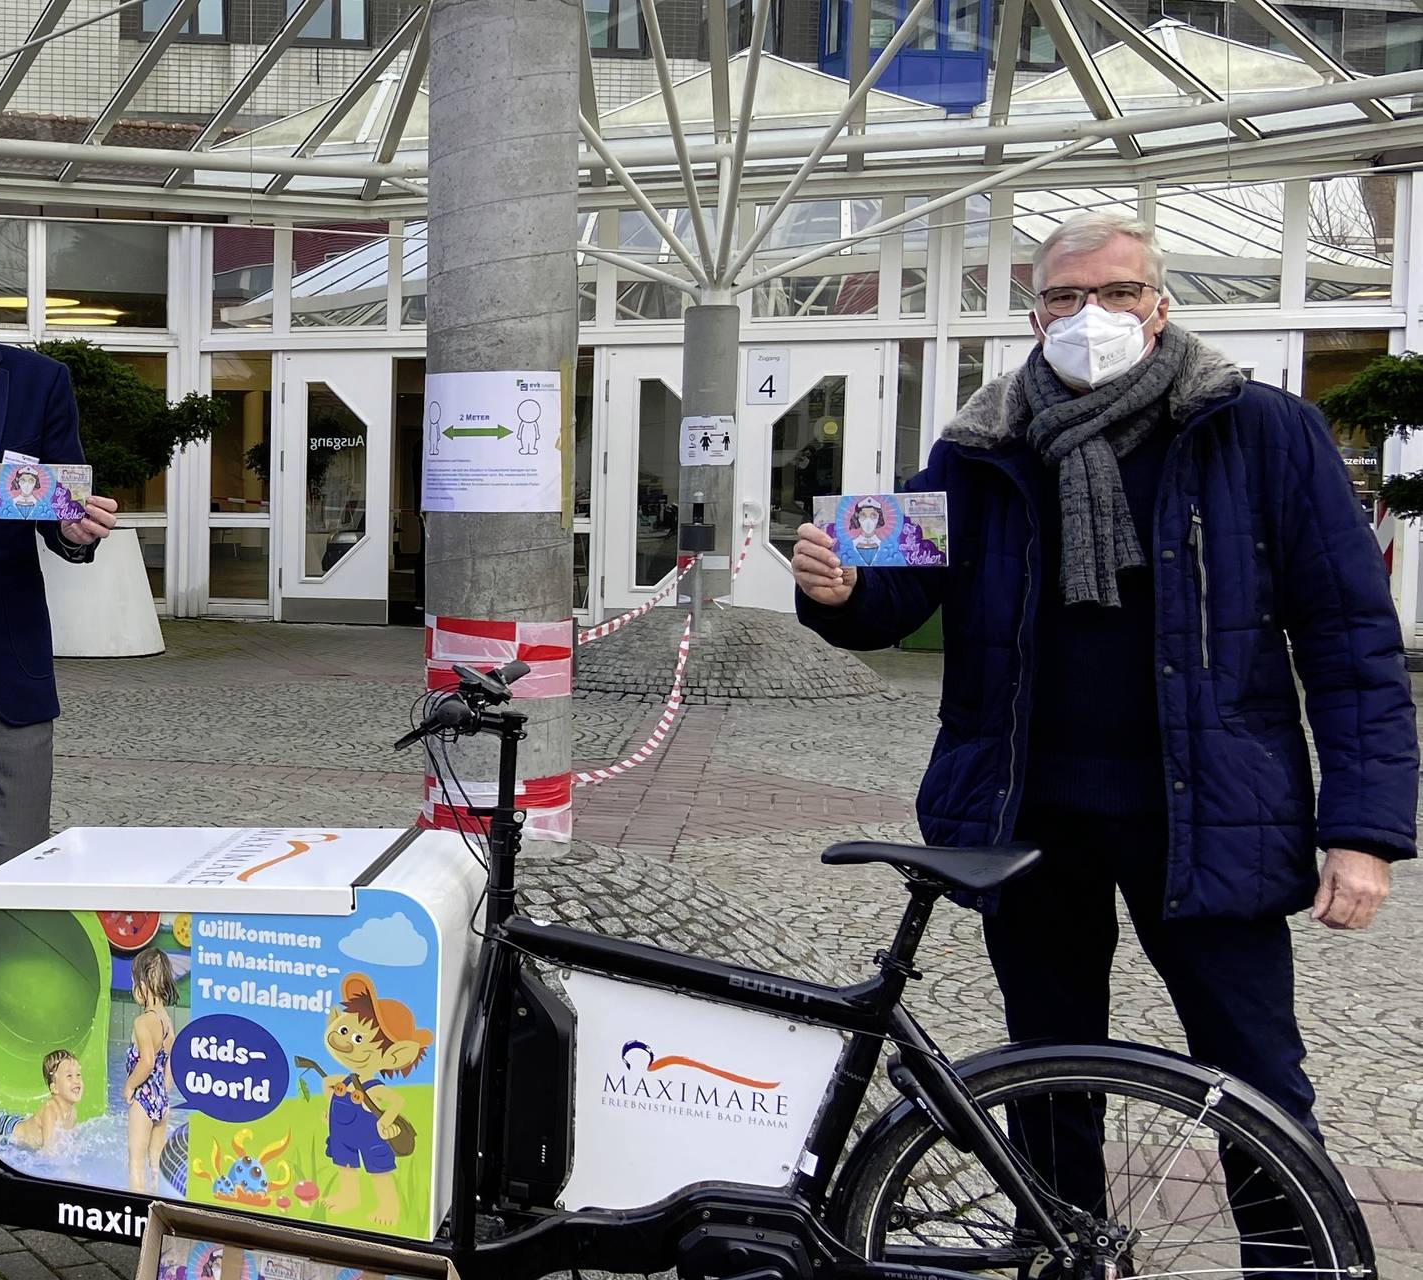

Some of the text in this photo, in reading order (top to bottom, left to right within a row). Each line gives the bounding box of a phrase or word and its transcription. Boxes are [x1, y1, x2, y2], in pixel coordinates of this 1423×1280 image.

[758, 374, 776, 398] 4
[198, 920, 321, 949] Willkommen
[198, 945, 340, 978] im Maximare-
[197, 978, 333, 1014] Trollaland!
[729, 974, 815, 1003] BULLITT
[190, 1036, 266, 1065] Kids-
[185, 1071, 270, 1103] World
[603, 1073, 789, 1116] MAXIMARE
[601, 1096, 788, 1129] ERLEBNISTHERME BAD HAMM
